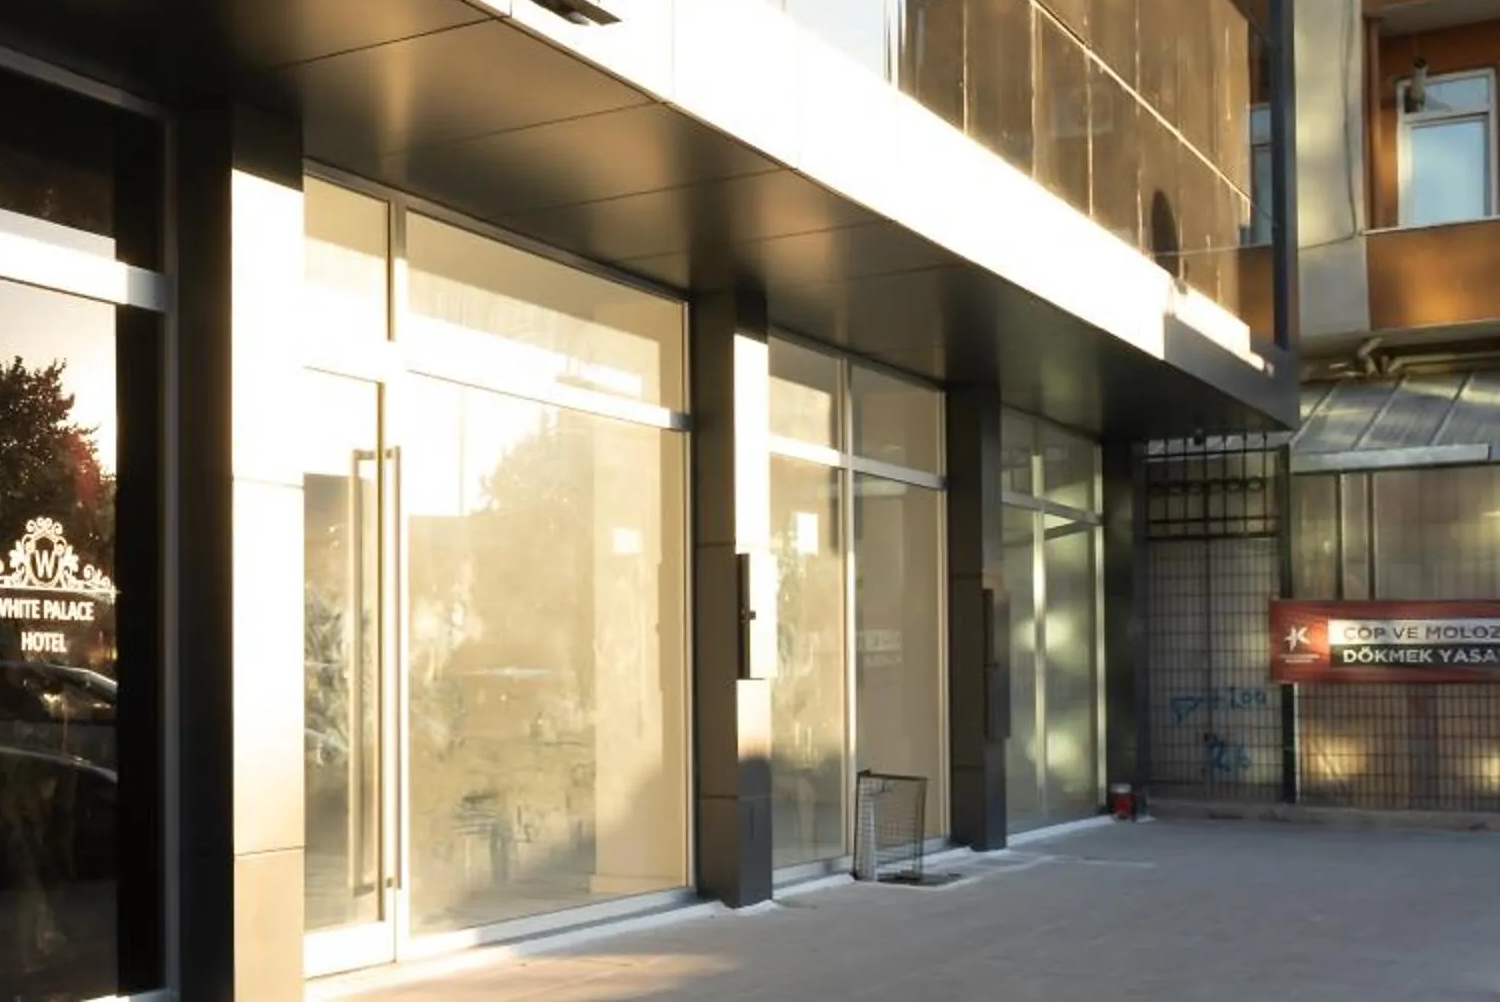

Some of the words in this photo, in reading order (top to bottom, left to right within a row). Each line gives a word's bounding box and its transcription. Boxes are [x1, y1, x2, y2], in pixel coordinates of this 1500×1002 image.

[35, 549, 56, 579] W
[43, 599, 95, 621] PALACE
[21, 631, 67, 653] HOTEL
[1392, 626, 1418, 640] VE
[1424, 625, 1500, 640] MOLOZ
[1342, 646, 1433, 664] DÖKMEK
[1436, 648, 1500, 664] YASA
